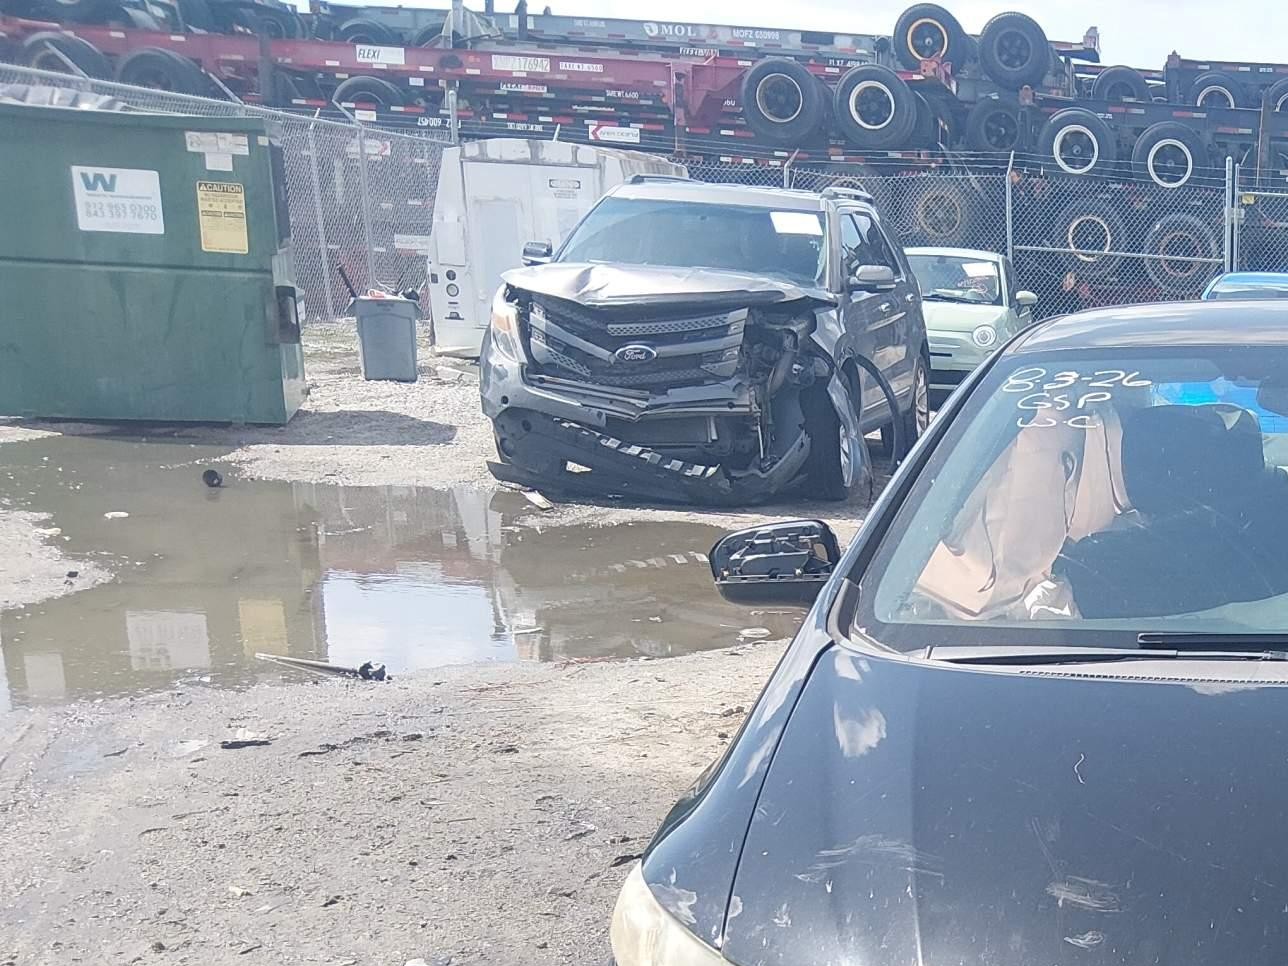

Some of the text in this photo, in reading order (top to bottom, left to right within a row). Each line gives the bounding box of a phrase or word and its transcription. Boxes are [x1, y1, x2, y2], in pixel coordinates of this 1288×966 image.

[661, 25, 696, 37] MOL
[357, 48, 381, 60] FLEXI
[207, 184, 242, 193] CAUTION
[623, 349, 647, 361] Ford
[1017, 391, 1112, 411] GSP
